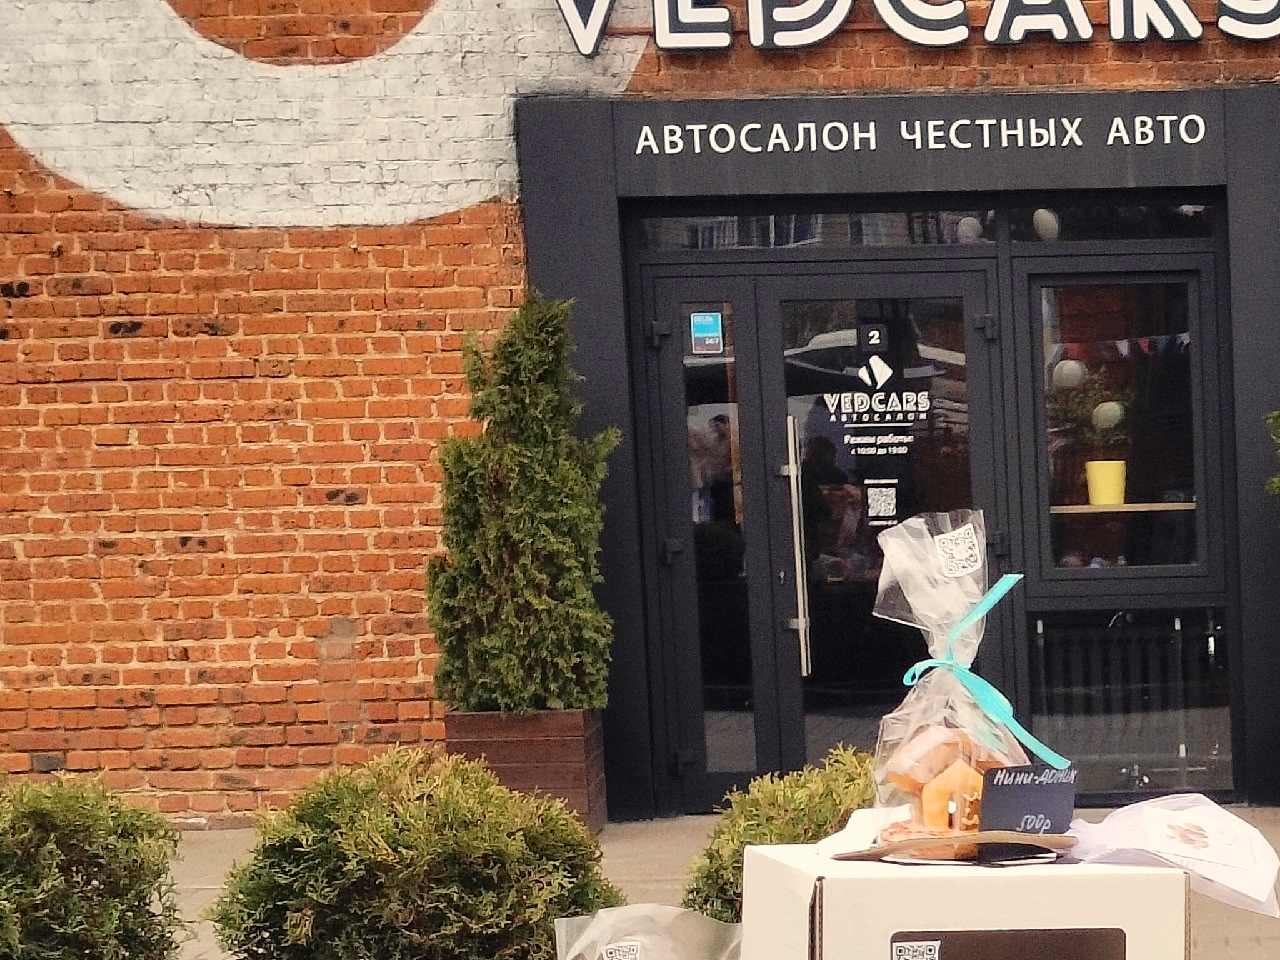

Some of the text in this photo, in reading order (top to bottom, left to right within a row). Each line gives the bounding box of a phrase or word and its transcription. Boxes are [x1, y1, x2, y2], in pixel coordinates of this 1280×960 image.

[635, 114, 1206, 155] АВТОСАЛОН ЧЕСТНЫХ АВТО
[868, 330, 880, 345] 2
[823, 391, 931, 414] VEDCARS
